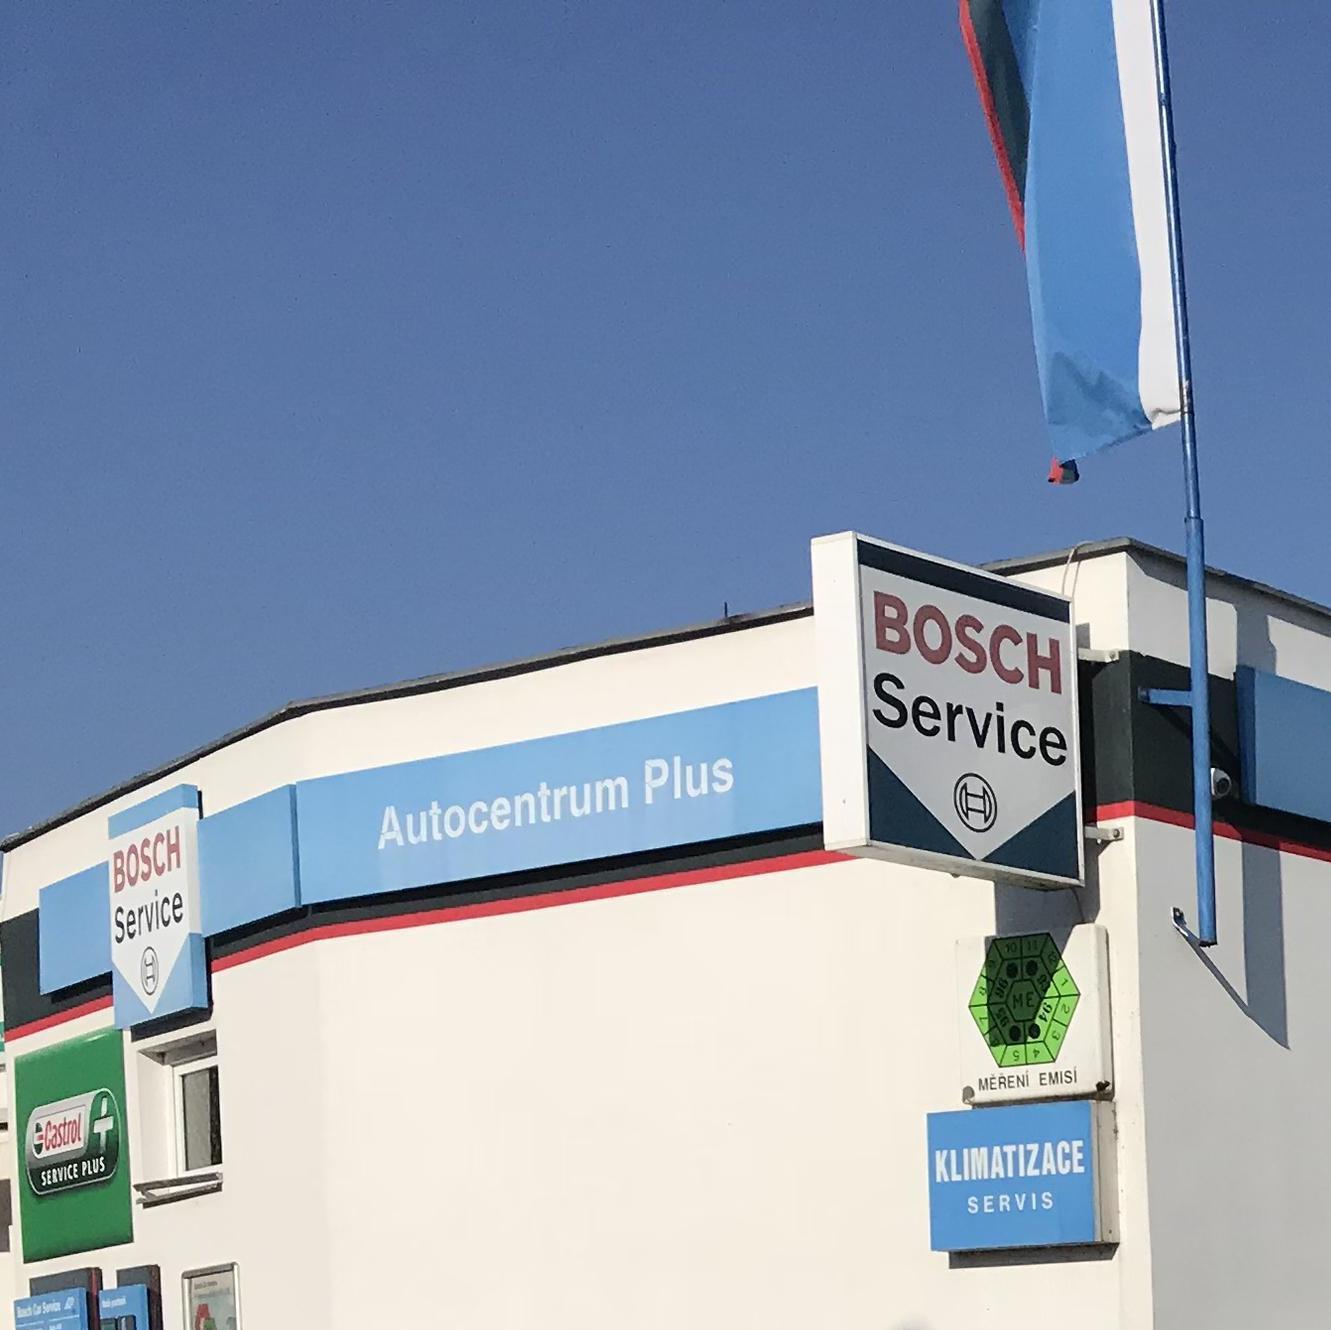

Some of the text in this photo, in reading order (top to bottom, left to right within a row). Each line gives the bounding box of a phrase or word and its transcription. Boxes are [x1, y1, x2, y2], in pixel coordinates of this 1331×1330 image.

[873, 590, 1063, 695] BOSCH
[872, 672, 1068, 766] Service
[378, 755, 734, 850] Autocentrum Plus
[113, 825, 181, 893] BOSCH
[114, 889, 183, 944] Service
[1005, 943, 1017, 953] 10
[1027, 941, 1038, 951] 11
[1013, 991, 1035, 1009] ME
[1061, 1003, 1070, 1014] 2
[1038, 1002, 1054, 1022] 94
[1052, 1030, 1060, 1041] 3
[1013, 1049, 1020, 1061] 5
[1032, 1048, 1040, 1057] 4
[978, 1066, 1077, 1091] MĚŘENÍ EMISÍ
[44, 1112, 81, 1151] Castrol
[41, 1156, 106, 1186] SERVICE PLUS
[935, 1139, 1086, 1183] KLIMATIZACE
[967, 1192, 1054, 1214] SERVIS
